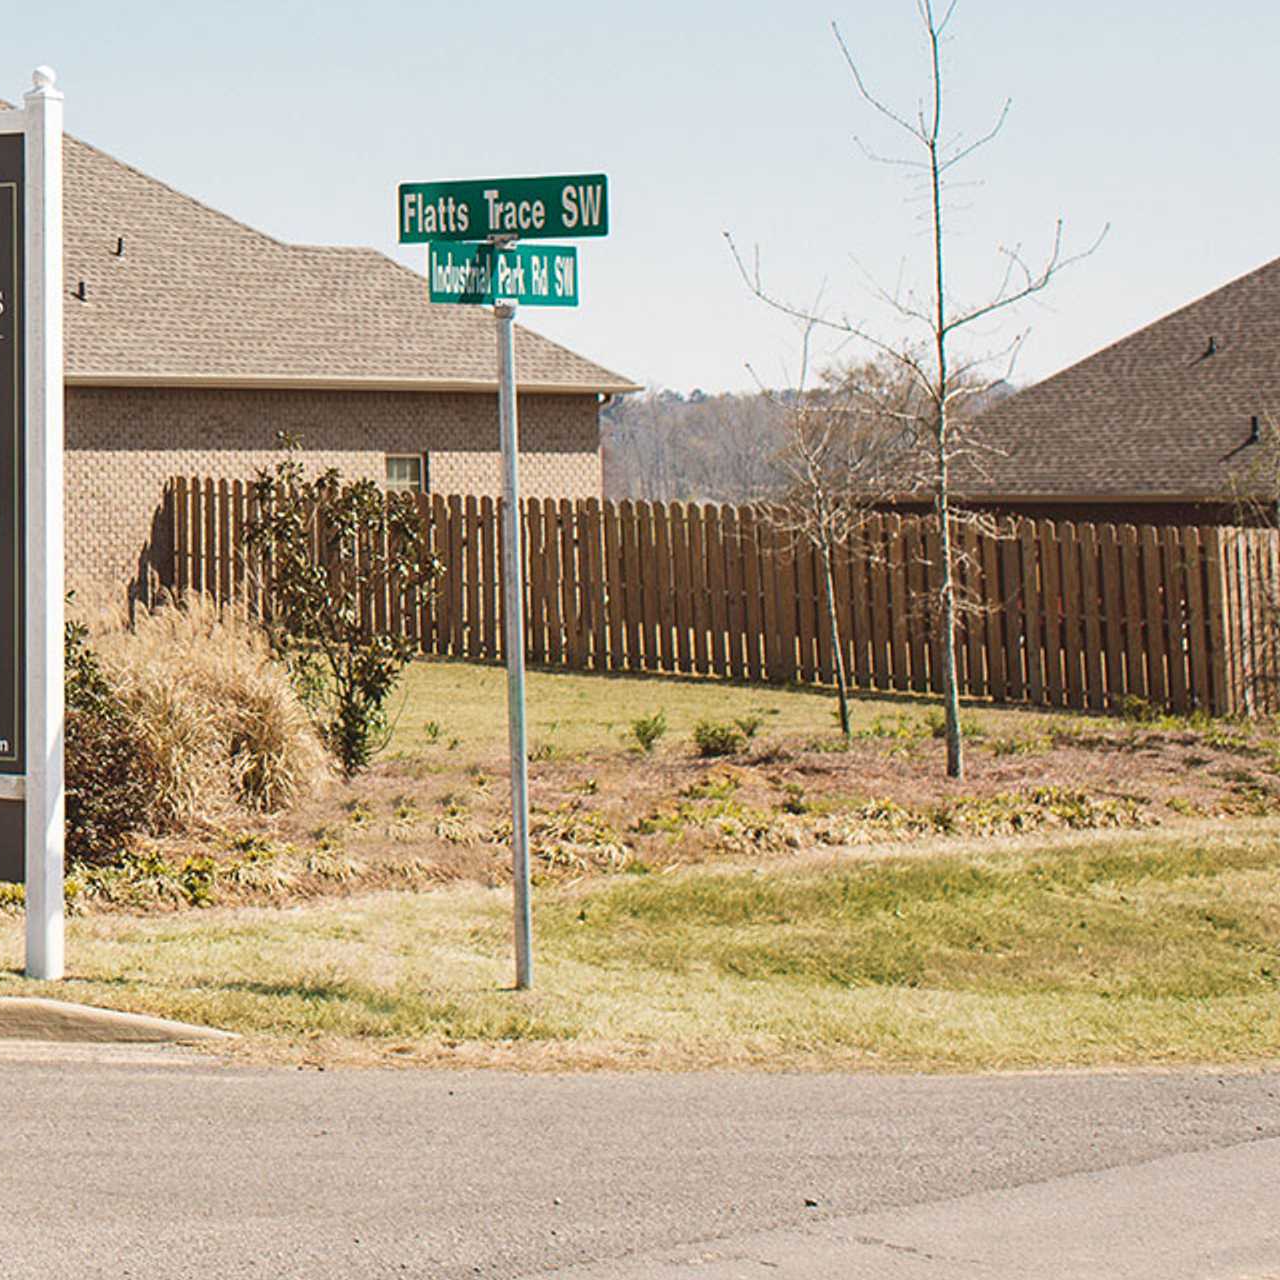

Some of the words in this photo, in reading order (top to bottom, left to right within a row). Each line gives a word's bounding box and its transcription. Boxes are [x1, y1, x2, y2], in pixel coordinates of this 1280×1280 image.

[403, 193, 469, 233] Flatts
[483, 189, 545, 230] Trace
[562, 185, 602, 228] SW
[432, 251, 492, 294] Industrial
[498, 254, 525, 294] Park
[532, 255, 548, 296] Rd
[555, 255, 574, 296] SW
